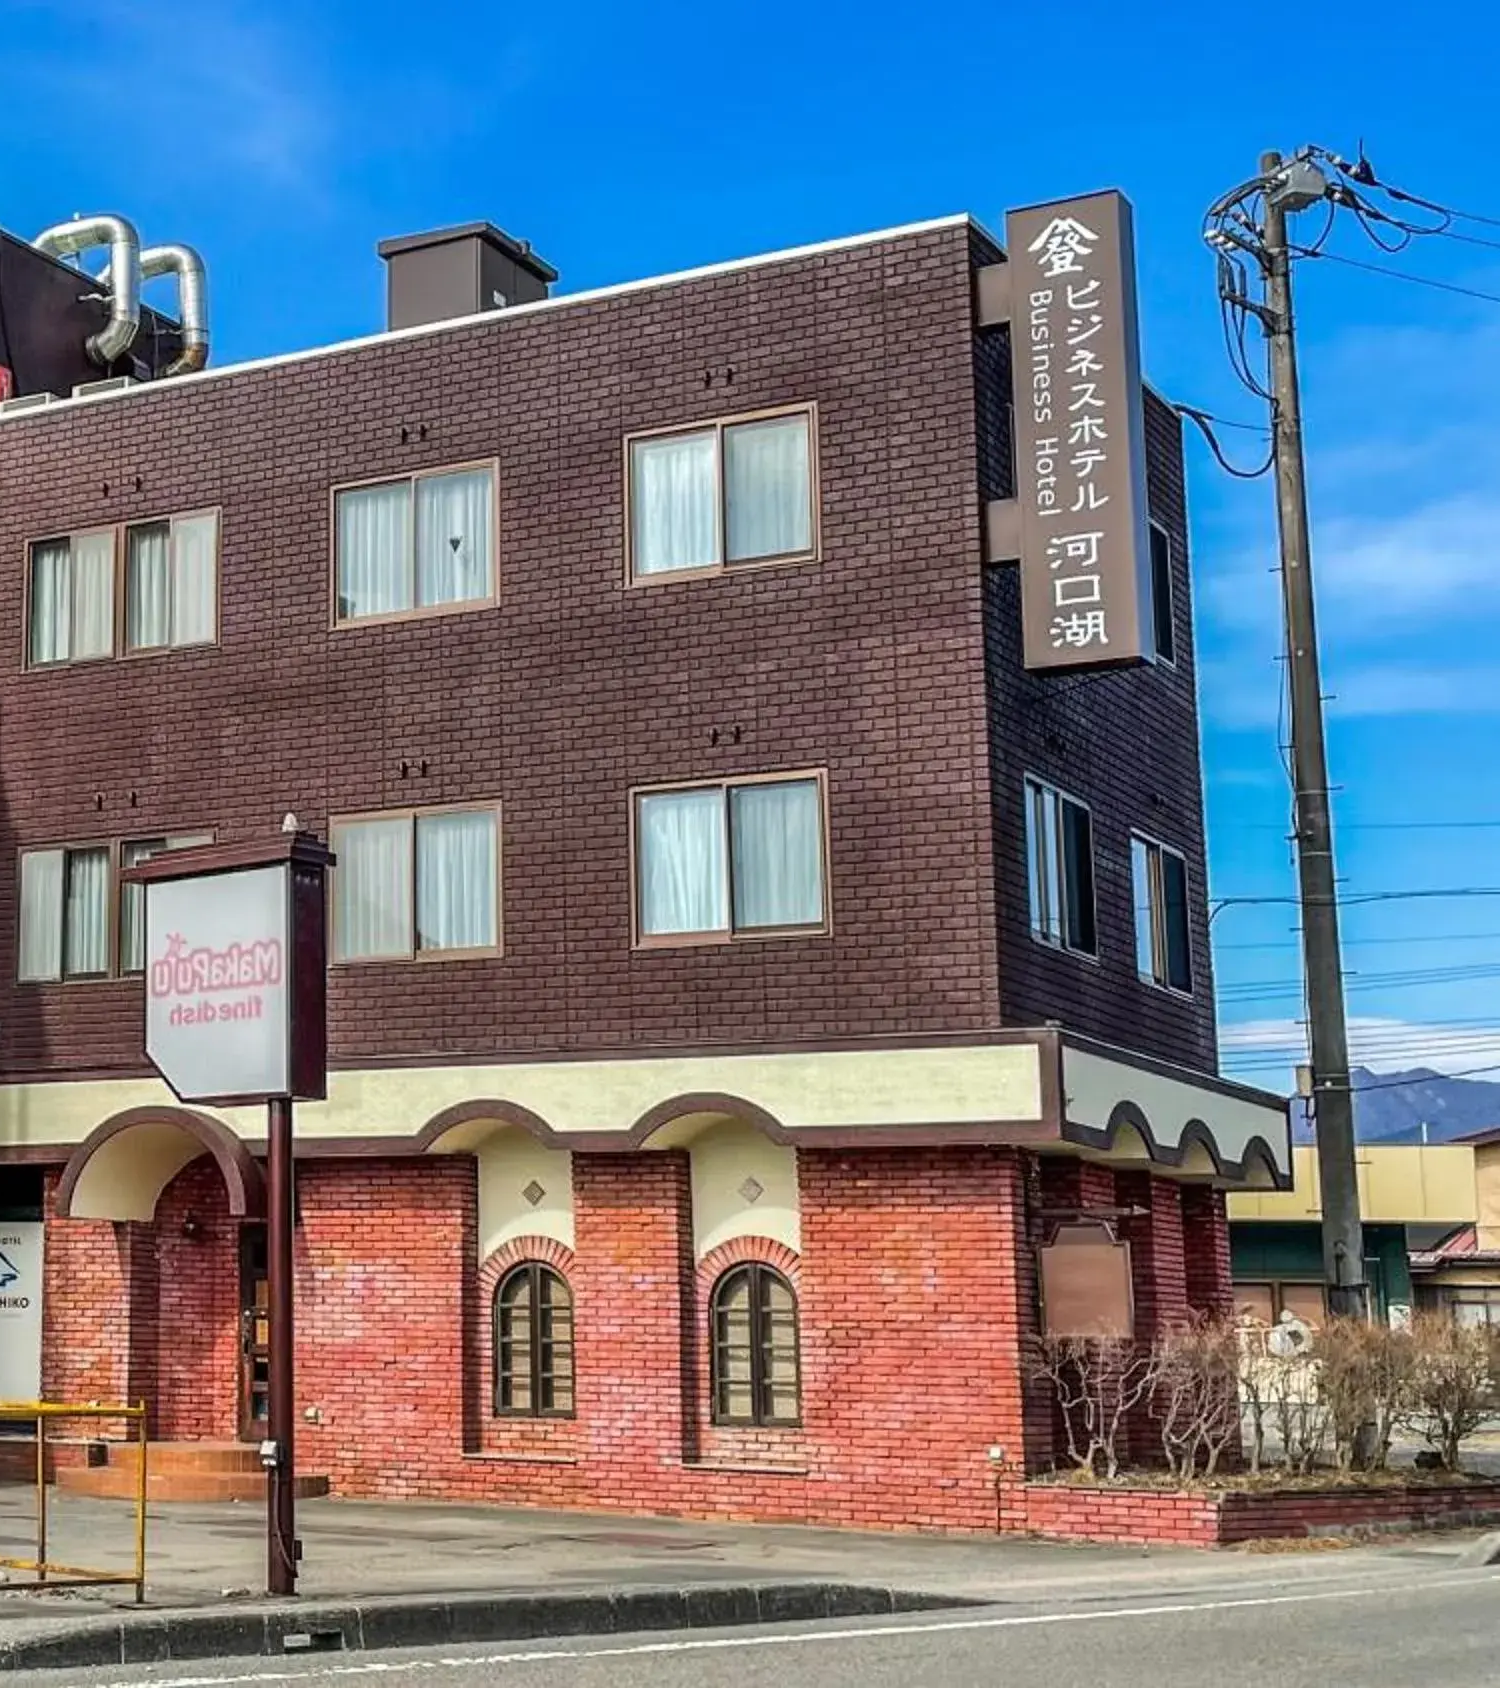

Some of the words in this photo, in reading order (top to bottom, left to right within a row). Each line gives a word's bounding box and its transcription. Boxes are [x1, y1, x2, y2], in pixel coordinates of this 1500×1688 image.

[1028, 289, 1055, 423] Business
[1065, 279, 1110, 512] ビジネスホテル
[1035, 437, 1063, 515] Hotel
[1046, 531, 1109, 648] 河口湖
